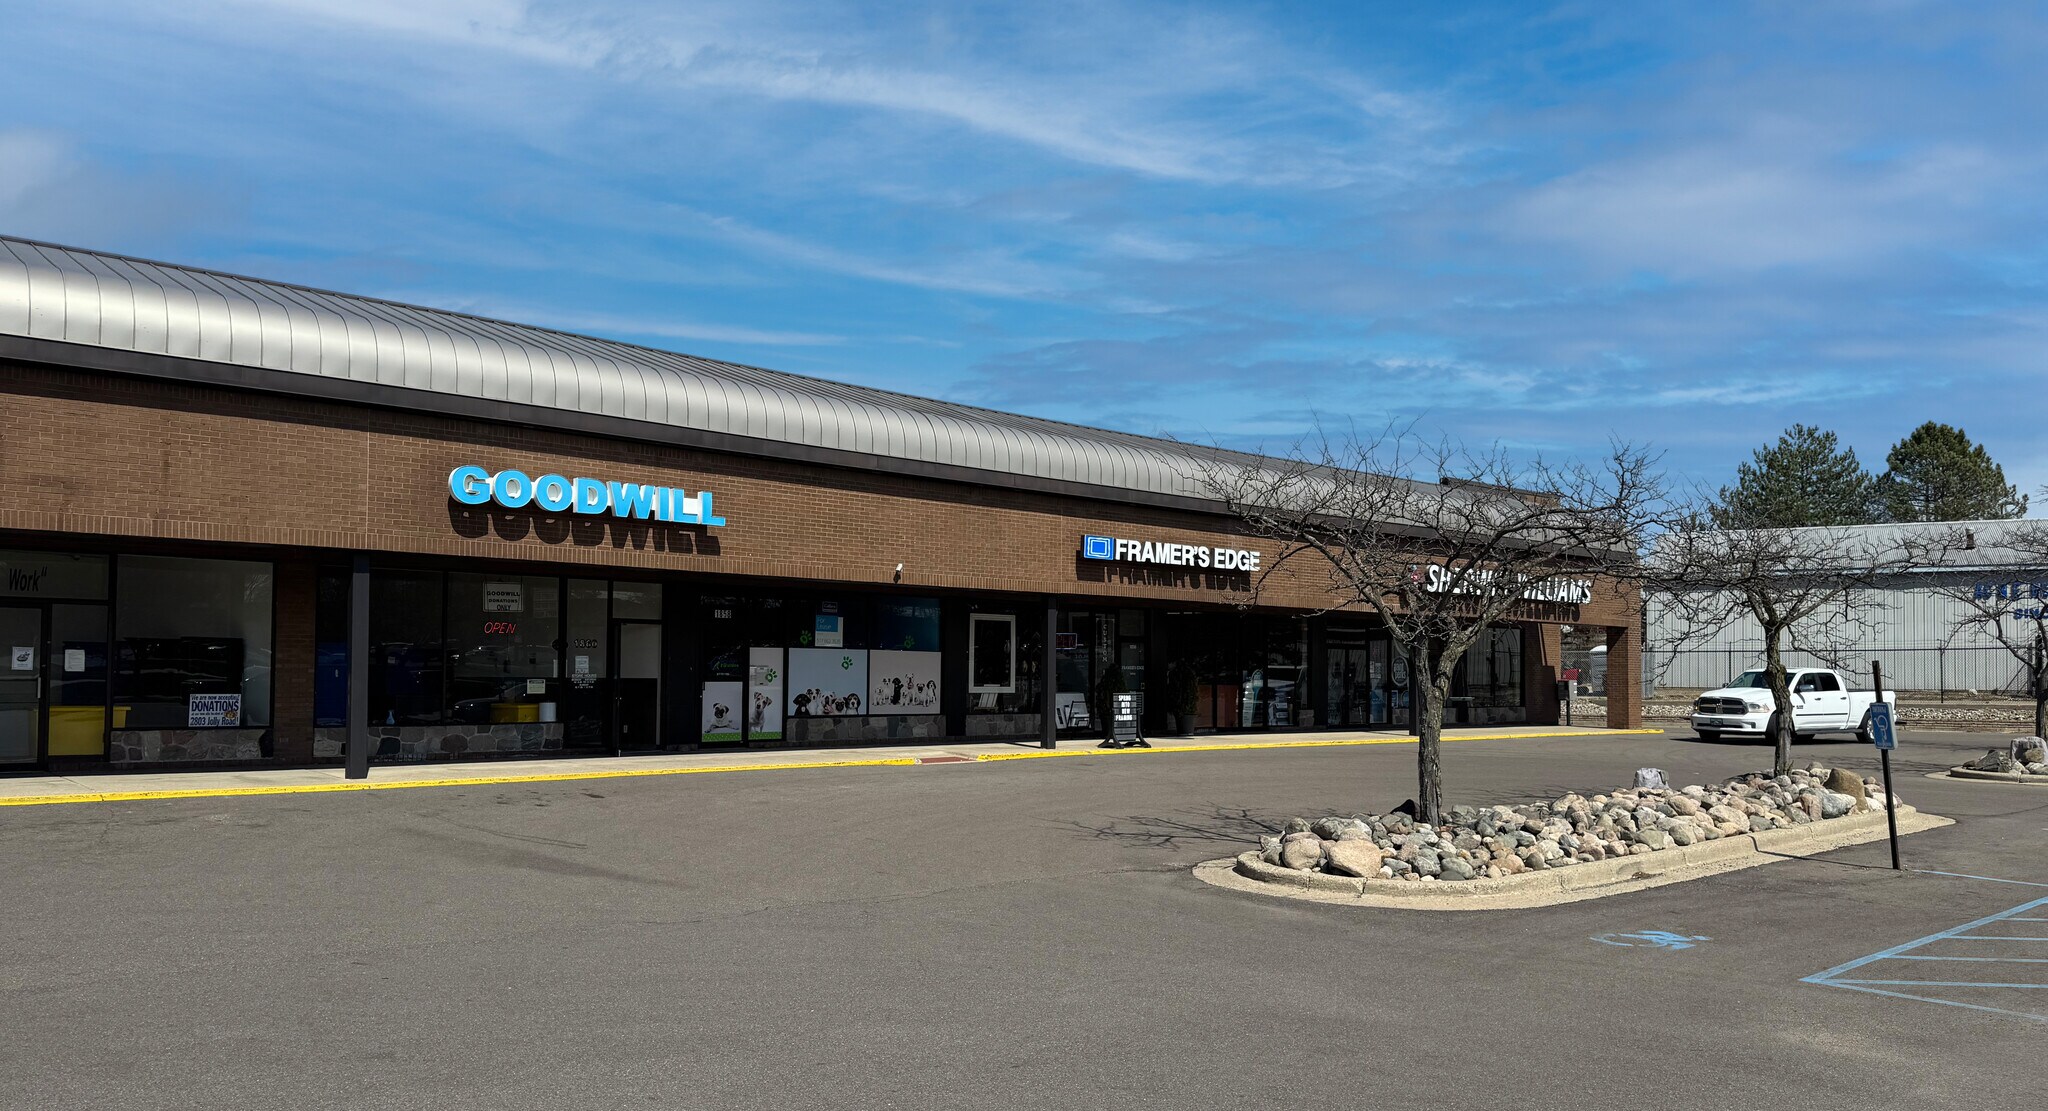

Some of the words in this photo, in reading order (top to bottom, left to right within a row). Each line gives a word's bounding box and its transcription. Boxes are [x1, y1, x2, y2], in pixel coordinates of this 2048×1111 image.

[448, 465, 726, 527] GOODWILL
[1115, 538, 1210, 568] FRAMER'S
[1213, 547, 1261, 572] EDGE
[484, 621, 516, 634] OPEN
[191, 700, 239, 712] DONATIONS
[190, 717, 206, 726] 2803
[207, 716, 220, 727] Jolly
